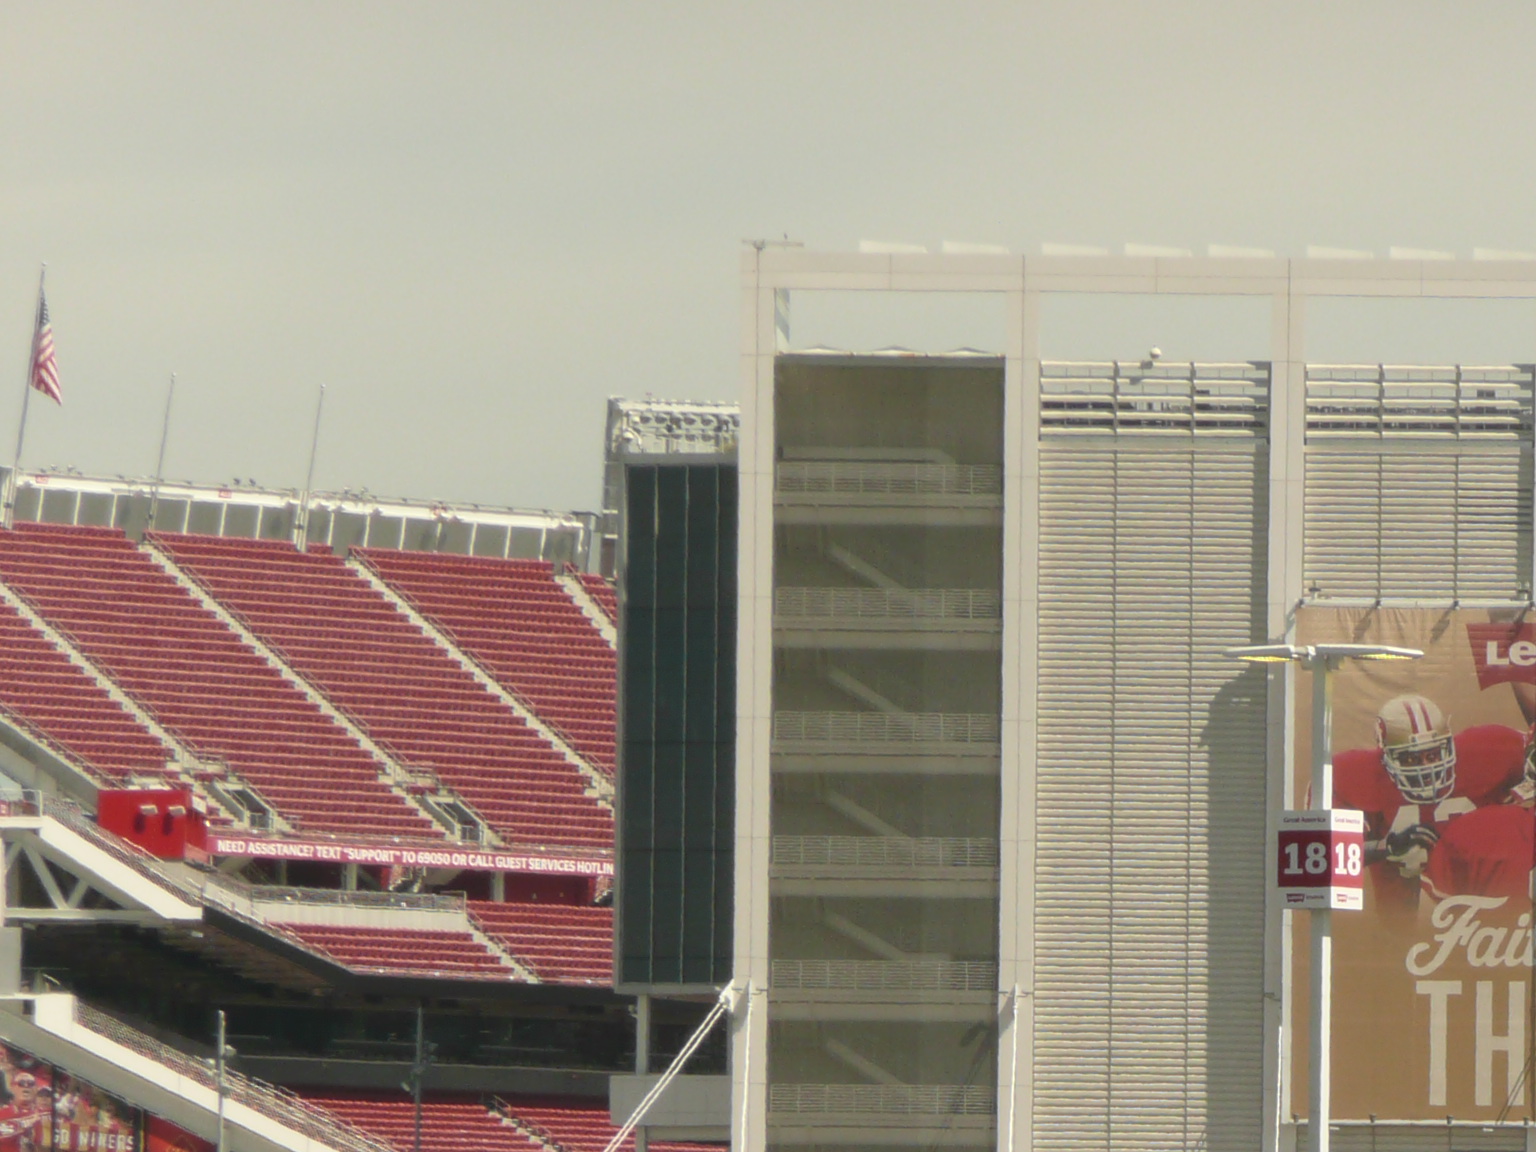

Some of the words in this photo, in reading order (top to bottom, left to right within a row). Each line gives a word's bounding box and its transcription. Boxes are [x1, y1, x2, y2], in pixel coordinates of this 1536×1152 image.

[217, 840, 246, 853] NEED
[247, 842, 314, 857] ASSISTANCE?
[316, 846, 342, 859] TEXT
[344, 848, 402, 862] "SUPPORT"
[402, 851, 416, 863] TO
[417, 852, 450, 865] 69050
[451, 853, 467, 866] OR
[468, 854, 494, 867] CALL
[495, 857, 527, 869] GUEST
[528, 858, 576, 872] SERVICES
[577, 861, 614, 875] HOTLIN
[1283, 842, 1328, 874] 18
[1335, 842, 1361, 876] 18
